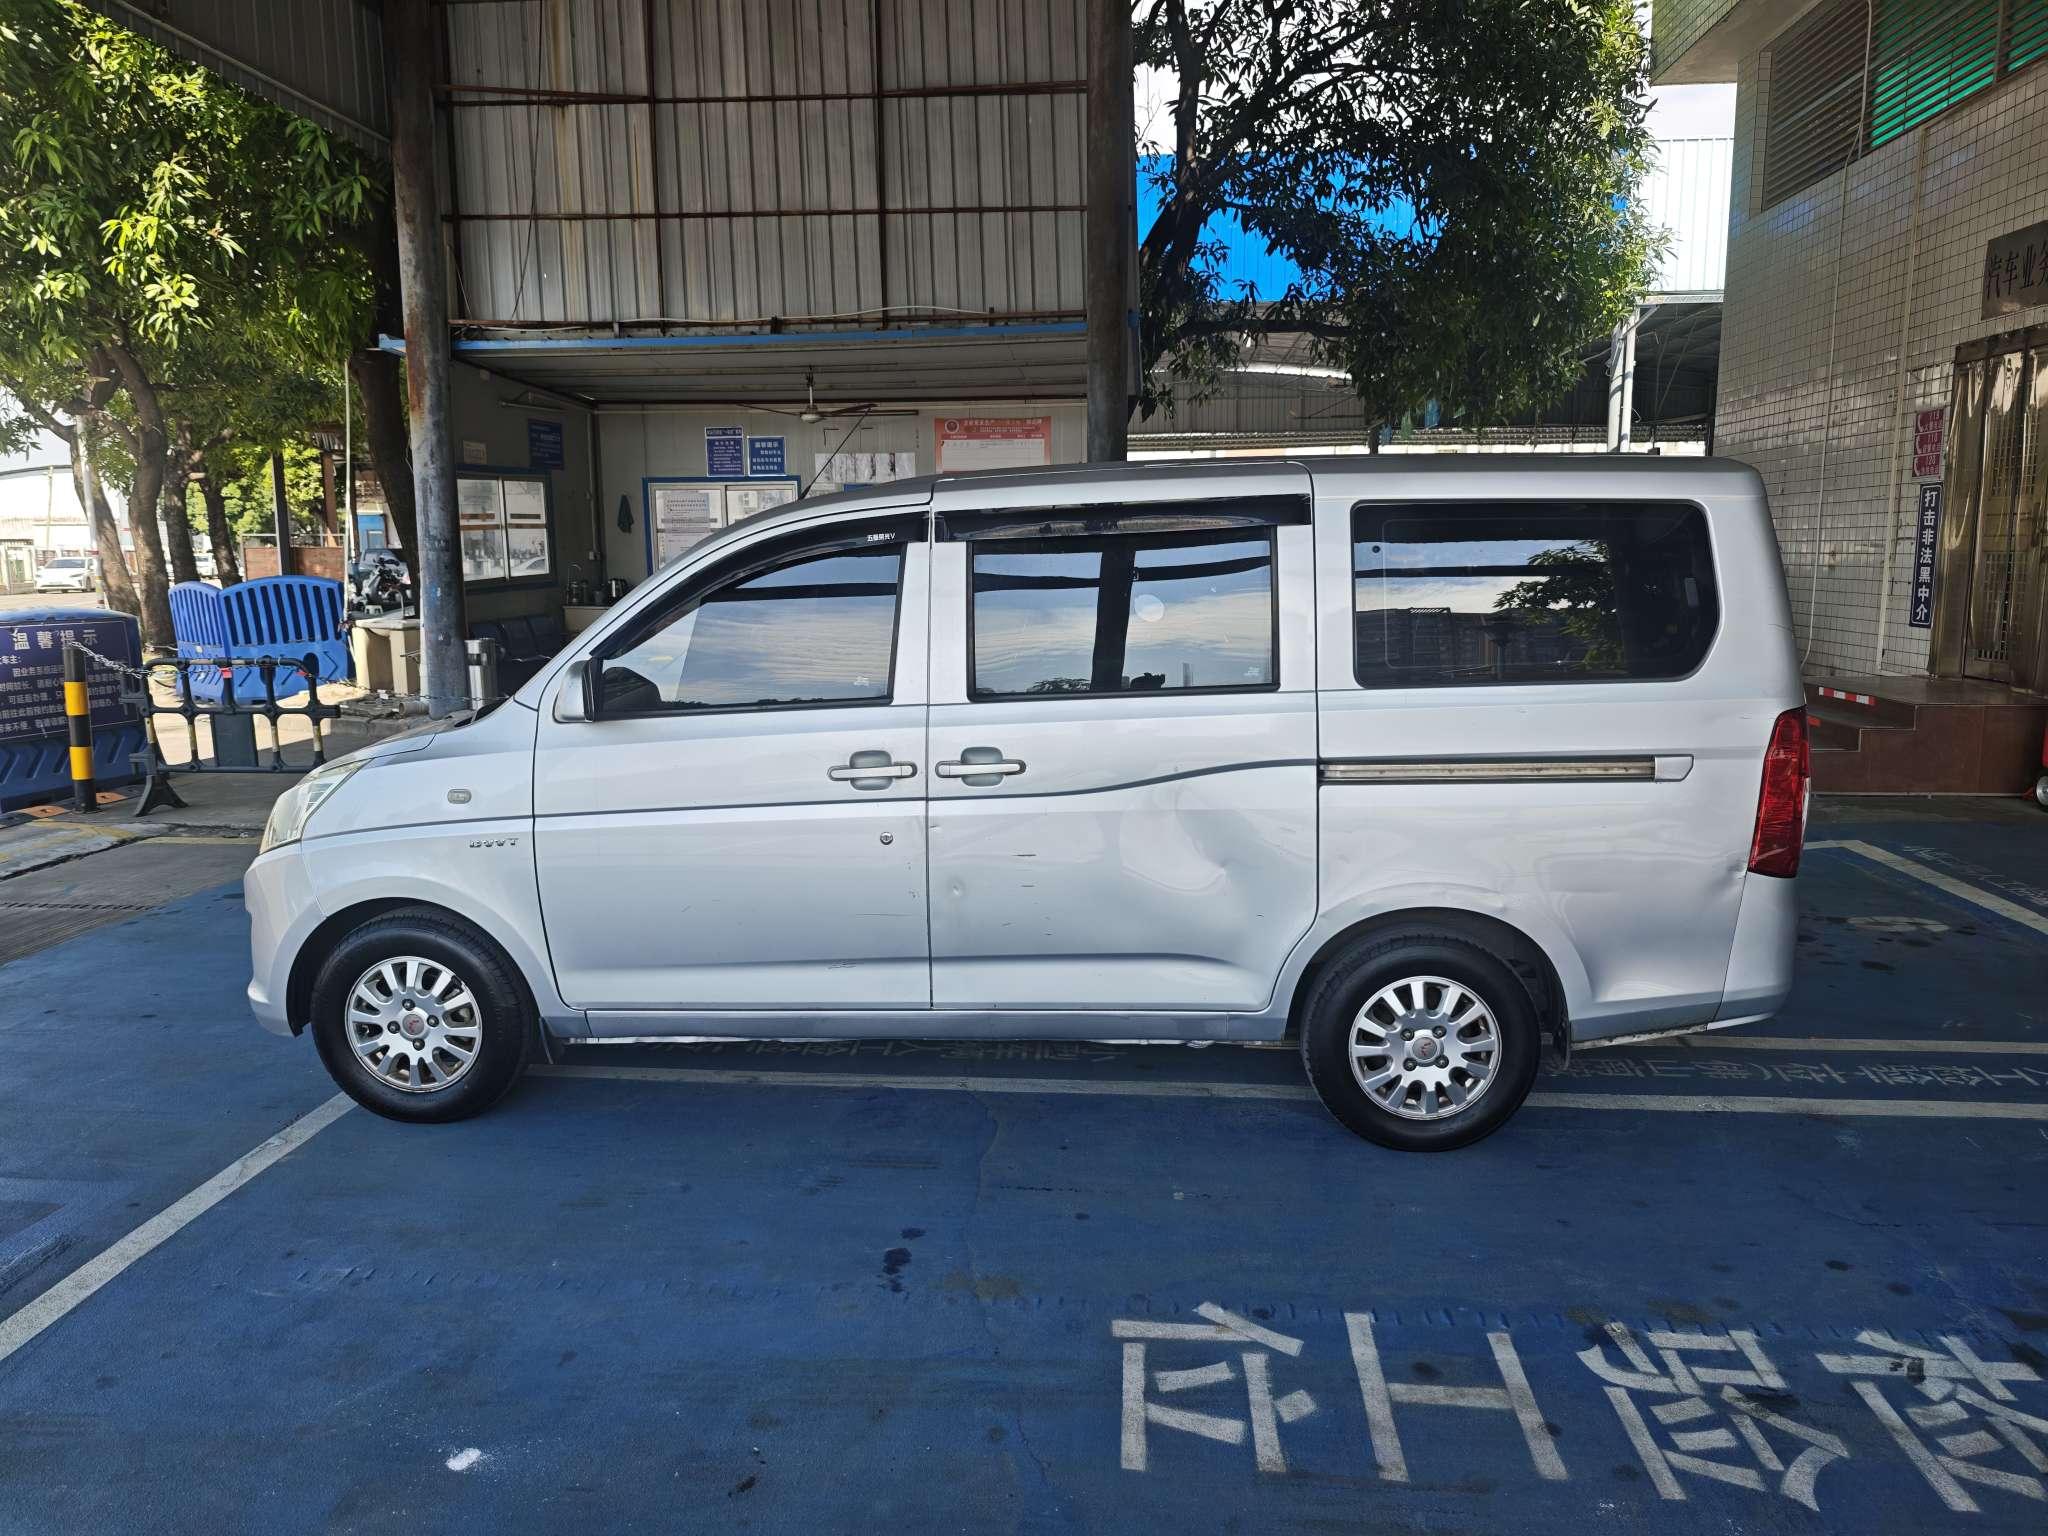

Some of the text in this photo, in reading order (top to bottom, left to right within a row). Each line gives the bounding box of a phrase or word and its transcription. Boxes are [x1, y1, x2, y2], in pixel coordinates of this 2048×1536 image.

[1916, 490, 1938, 621] 打击非法黑中介
[9, 627, 98, 650] 温馨提示
